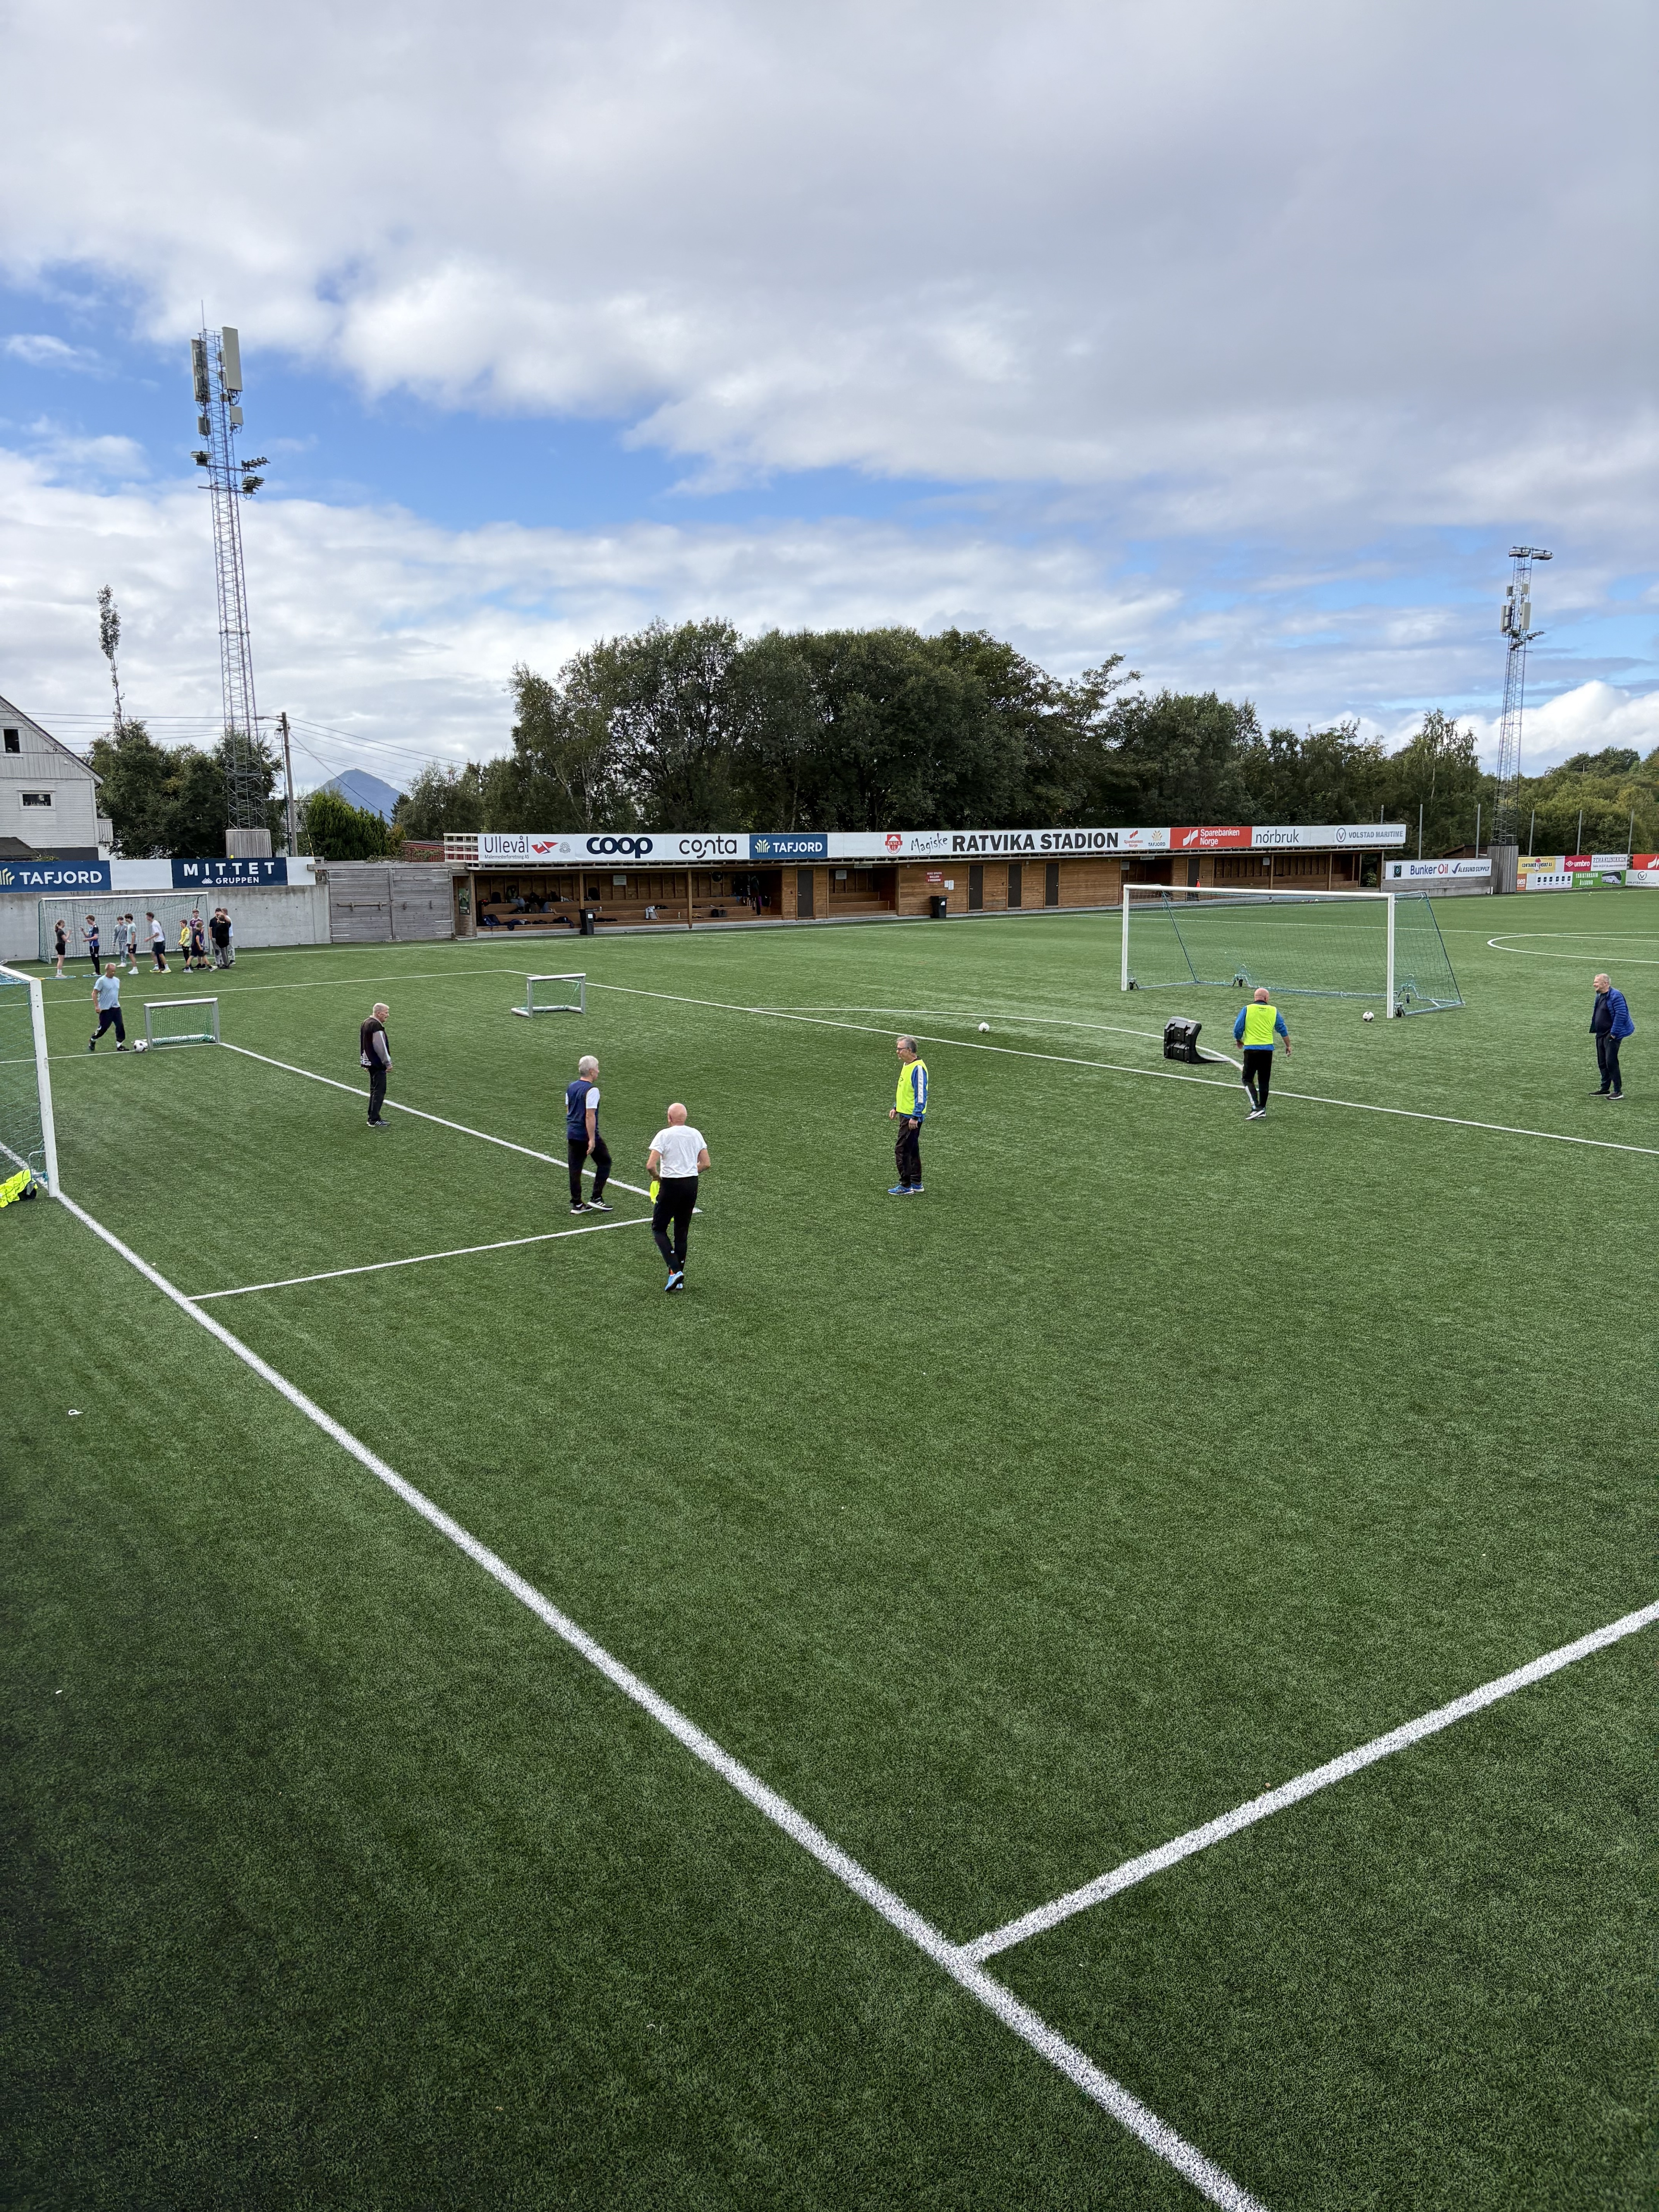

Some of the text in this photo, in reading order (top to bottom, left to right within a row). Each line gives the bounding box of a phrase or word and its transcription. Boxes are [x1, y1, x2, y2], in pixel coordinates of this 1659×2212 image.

[1200, 829, 1240, 837] Sparebanken
[1256, 829, 1299, 843] nórbruk
[484, 835, 529, 853] Ullevål
[586, 837, 653, 859] coop
[679, 835, 737, 859] conta
[773, 842, 823, 853] TAFJORD
[911, 832, 1118, 854] Magiske RATVIKA STADION
[1200, 838, 1218, 847] Norge
[184, 862, 275, 876] MITTET
[1410, 864, 1448, 875] Bunker Oil
[19, 871, 102, 884] TAFJORD
